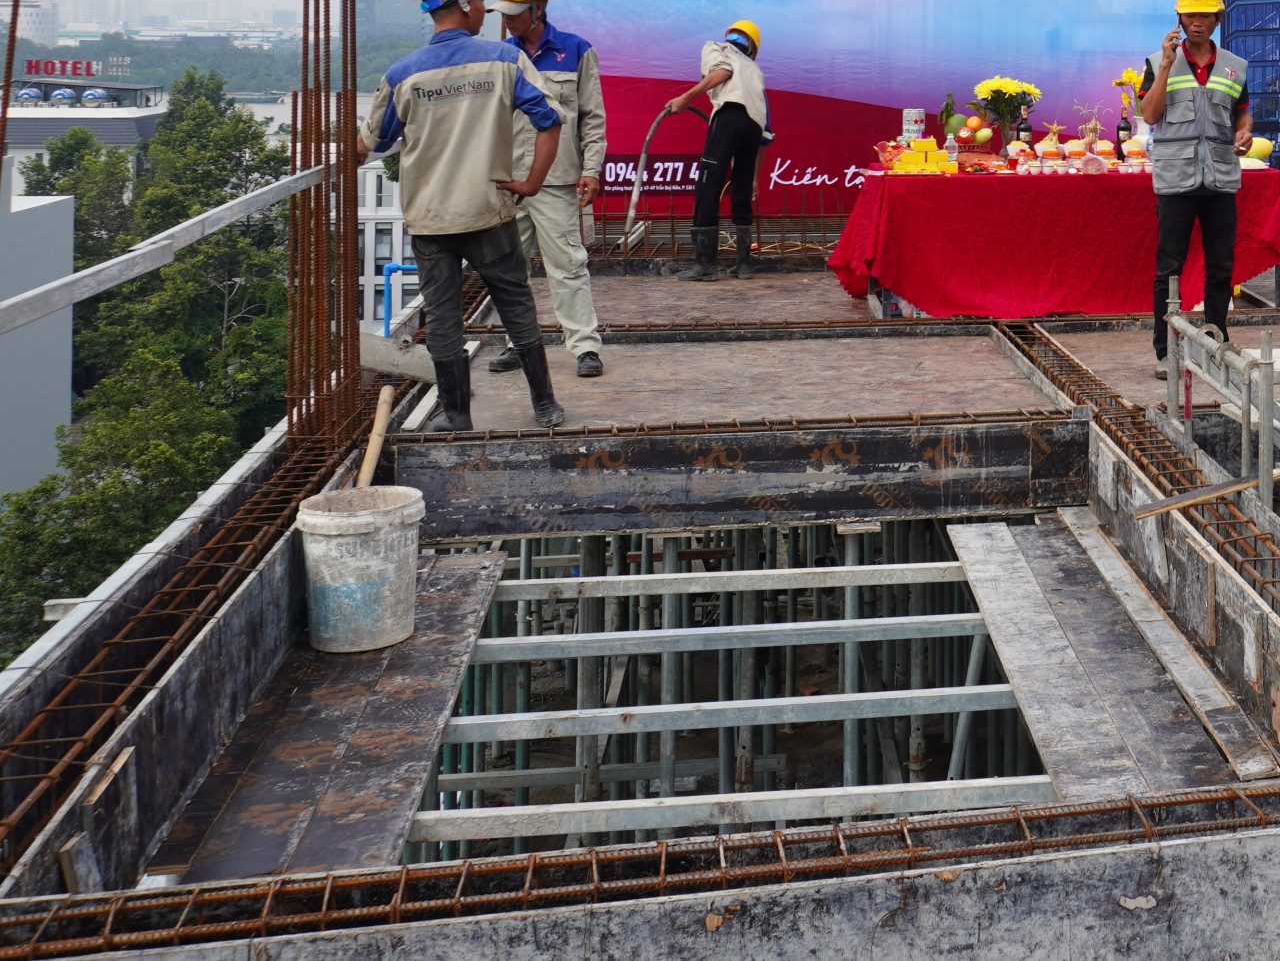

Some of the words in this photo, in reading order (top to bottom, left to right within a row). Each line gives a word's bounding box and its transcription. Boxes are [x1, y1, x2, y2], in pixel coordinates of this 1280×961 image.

[26, 59, 96, 77] HOTEL
[413, 86, 443, 102] Tipu
[653, 162, 684, 182] 277
[769, 157, 839, 190] Kiến
[843, 164, 866, 189] tạ
